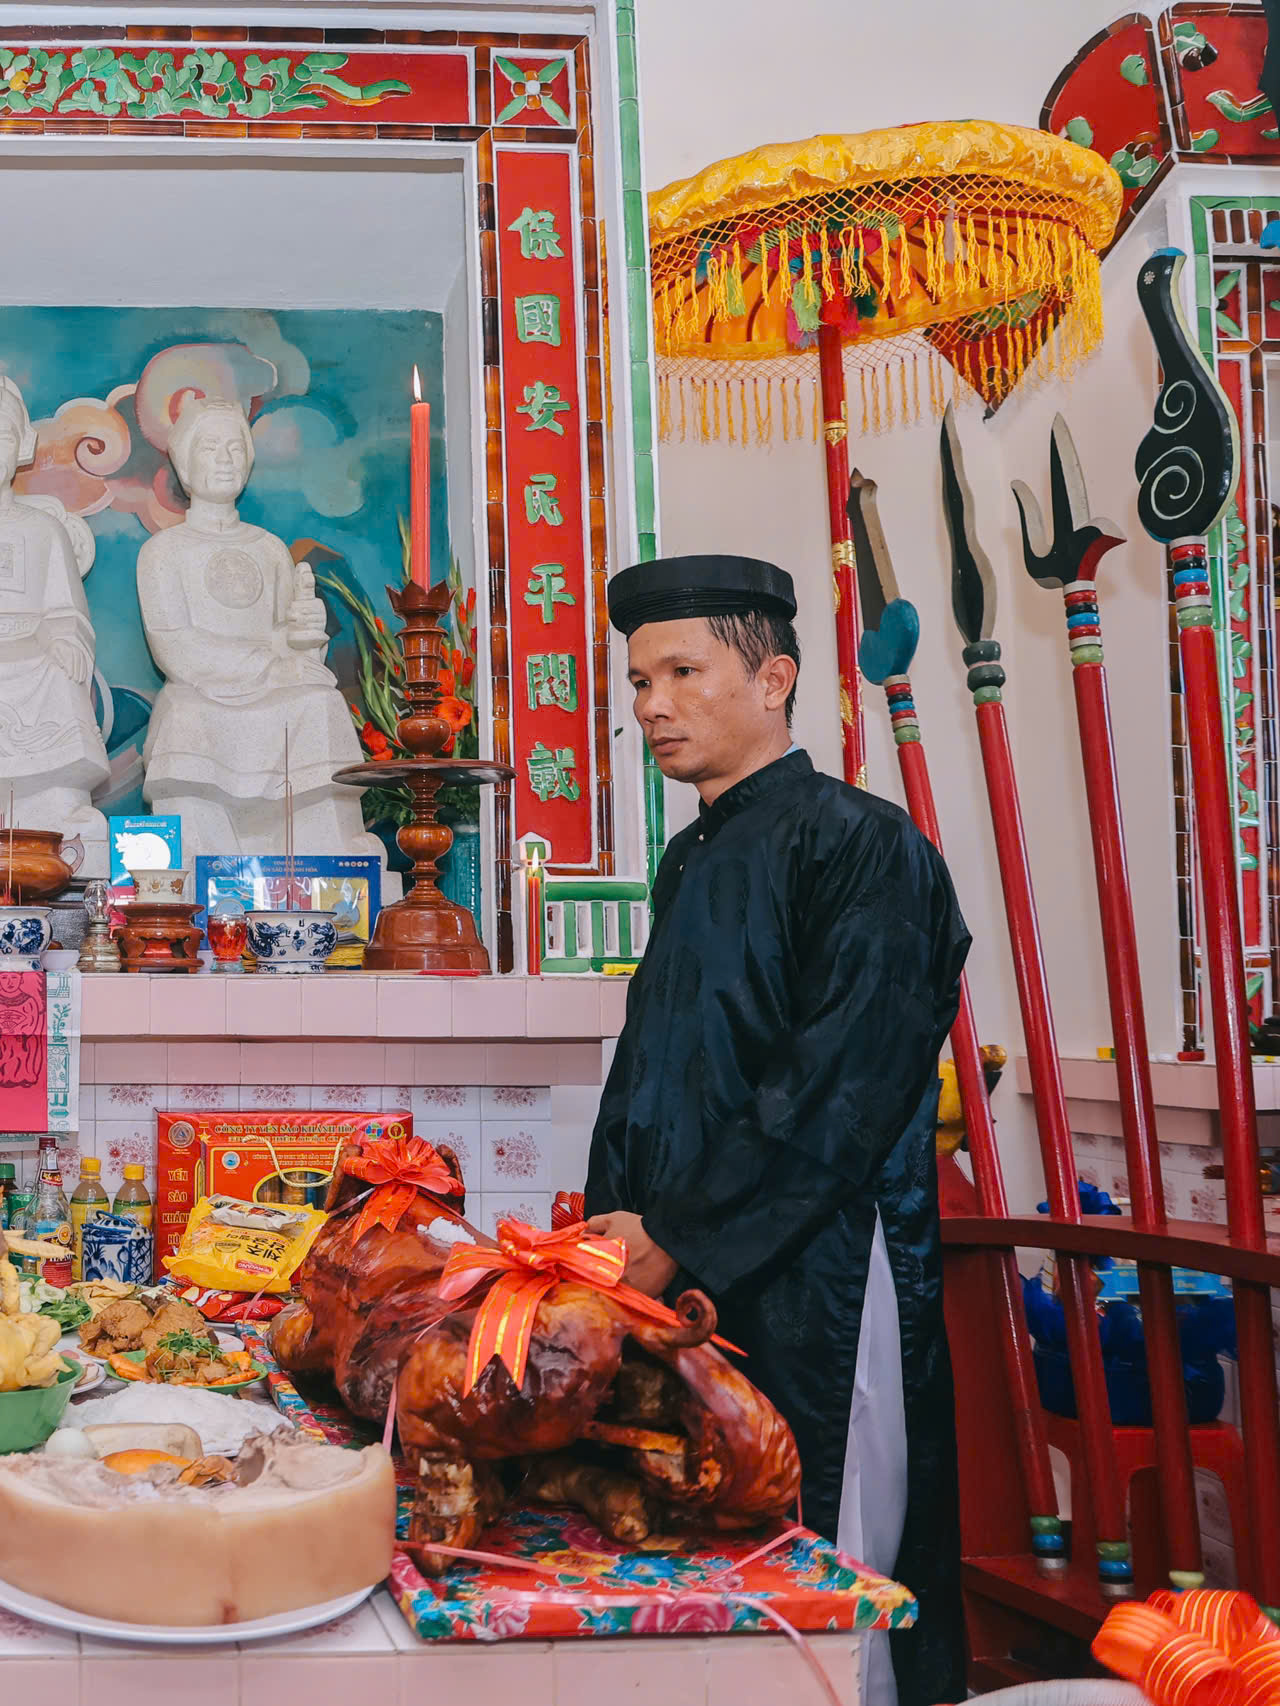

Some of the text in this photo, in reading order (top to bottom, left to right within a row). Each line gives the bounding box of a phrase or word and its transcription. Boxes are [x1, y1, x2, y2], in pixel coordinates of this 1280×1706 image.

[215, 1123, 242, 1134] CÔNG
[244, 1124, 257, 1134] TY
[258, 1122, 279, 1134] YẾN
[280, 1123, 300, 1134] SÀO
[301, 1122, 336, 1134] KHÁNH
[167, 1168, 188, 1181] YẾN
[168, 1189, 188, 1202] SÀO
